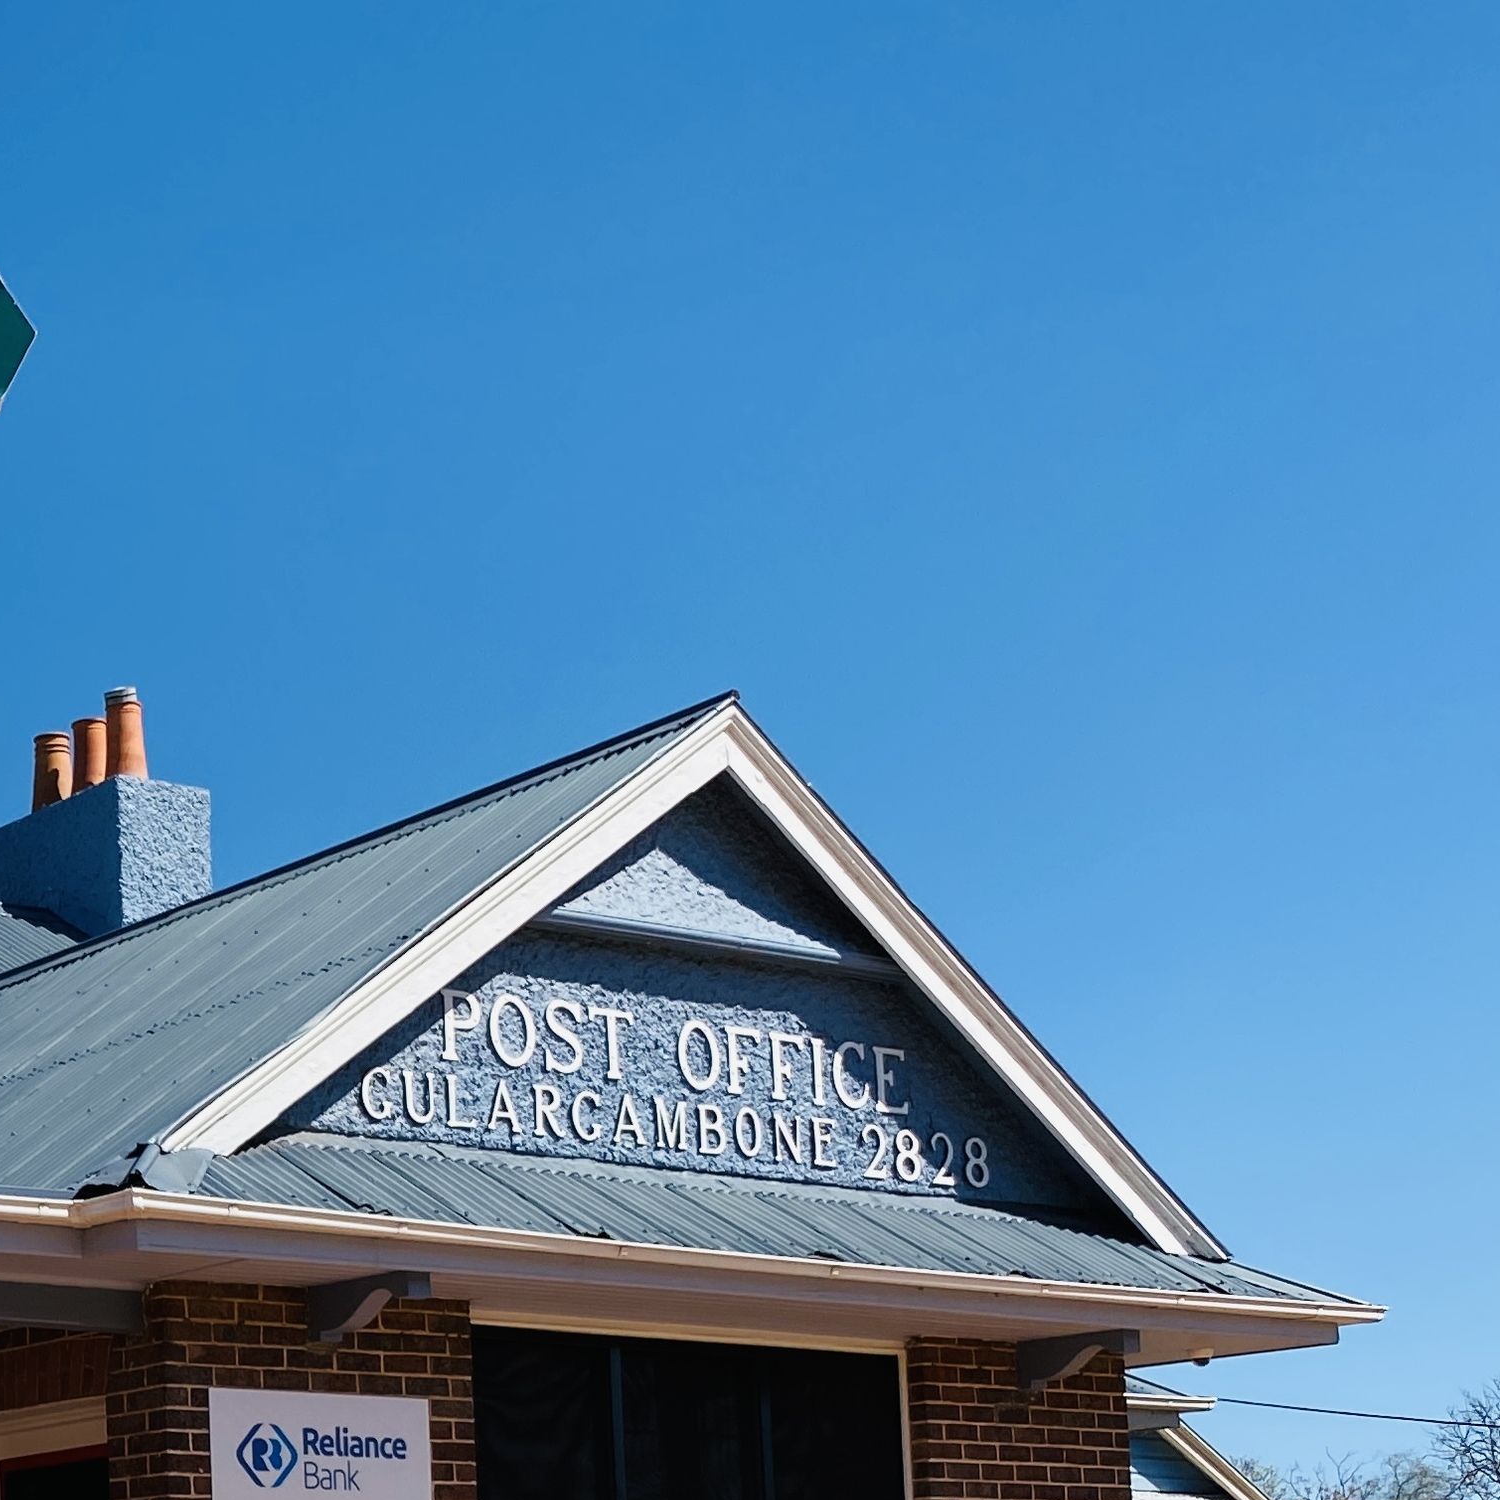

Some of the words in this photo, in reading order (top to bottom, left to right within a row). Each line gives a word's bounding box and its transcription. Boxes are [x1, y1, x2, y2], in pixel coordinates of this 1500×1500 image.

[440, 989, 634, 1080] POST
[677, 1020, 909, 1114] OFFICE
[361, 1066, 838, 1169] GULARGAMBONE
[861, 1125, 990, 1188] 2828
[302, 1427, 407, 1460] Reliance
[304, 1461, 361, 1491] Bank
